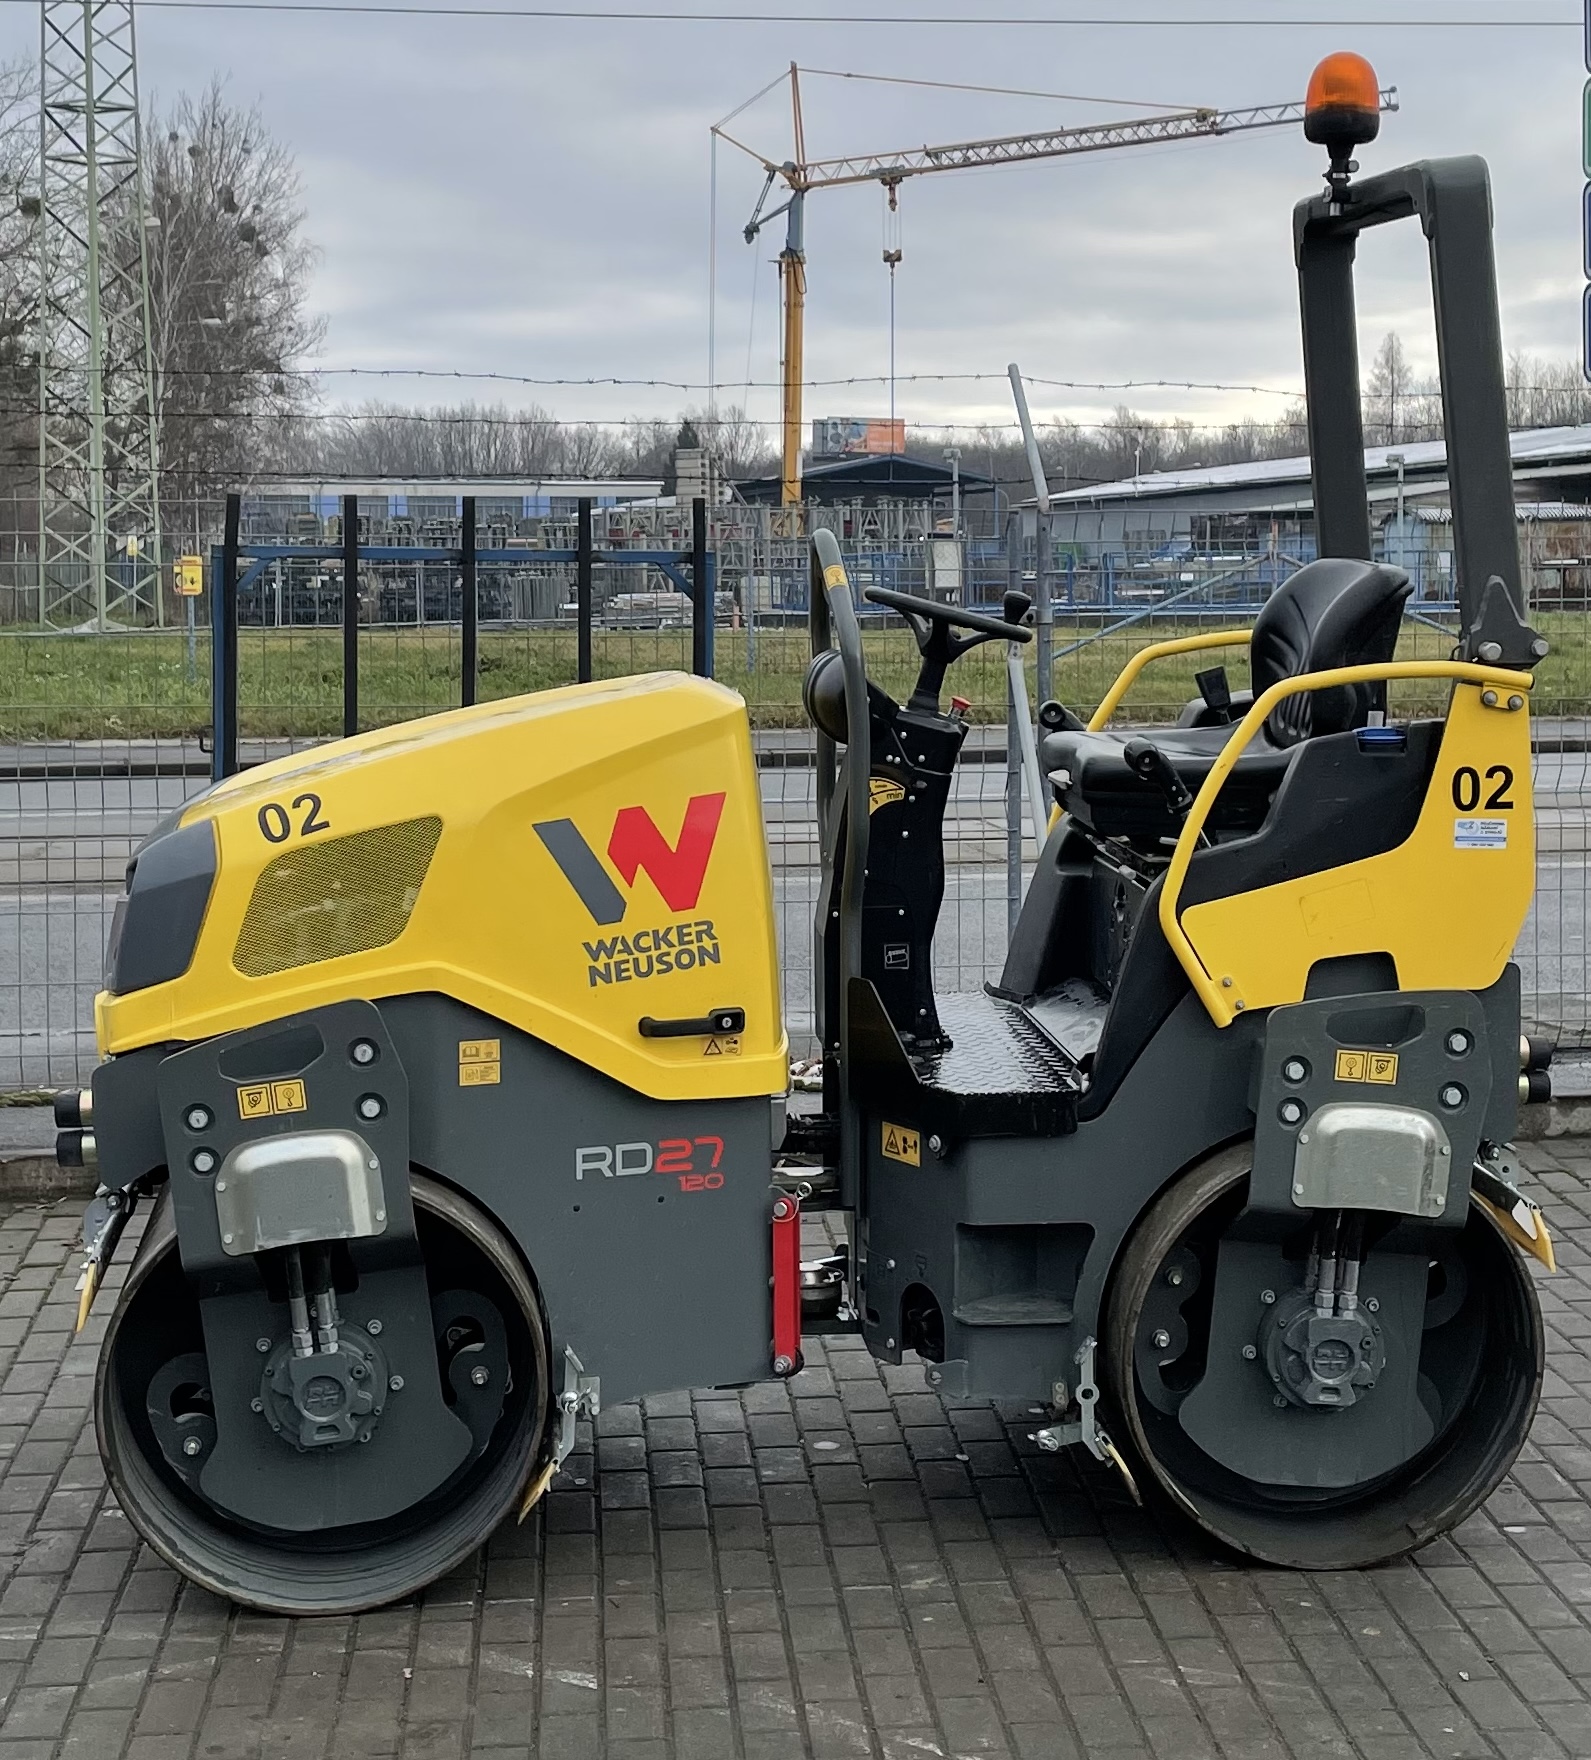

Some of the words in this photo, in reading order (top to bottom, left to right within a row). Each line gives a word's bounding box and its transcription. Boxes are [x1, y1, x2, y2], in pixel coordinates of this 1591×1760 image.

[886, 790, 903, 800] min
[1452, 765, 1514, 811] 02
[258, 793, 331, 843] 02
[582, 920, 718, 962] WACKER
[588, 942, 721, 987] NEUSON
[575, 1134, 725, 1180] RD27
[678, 1172, 725, 1192] 120
